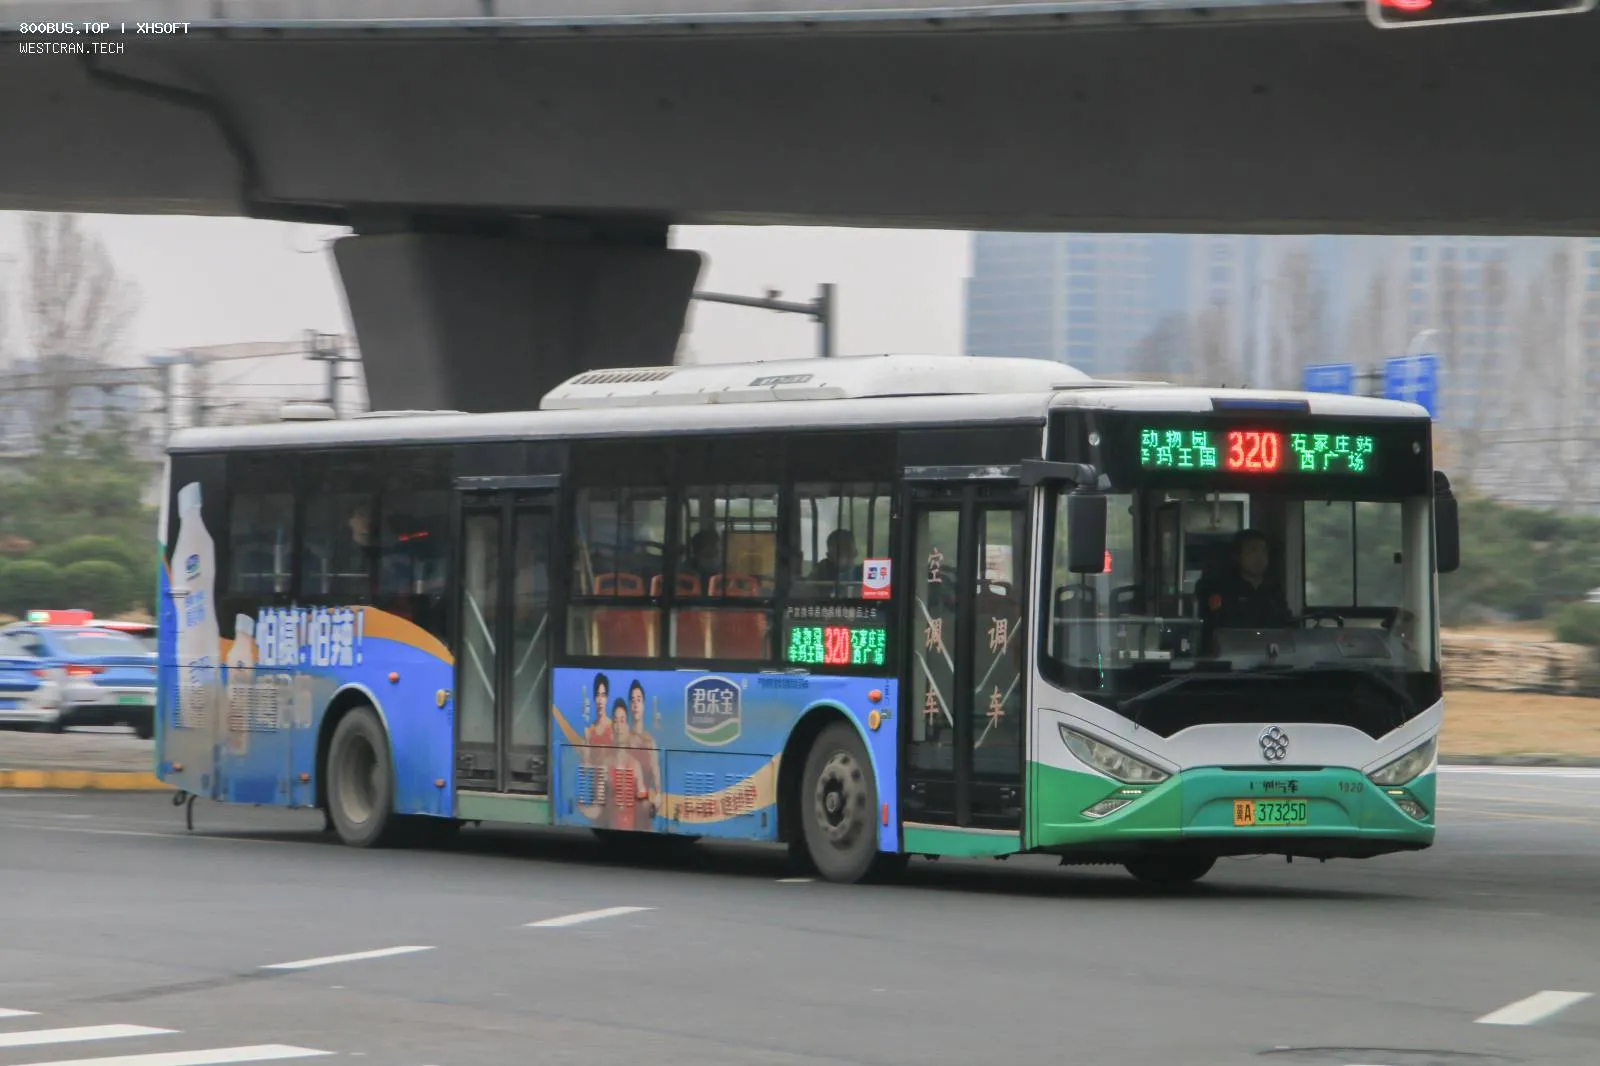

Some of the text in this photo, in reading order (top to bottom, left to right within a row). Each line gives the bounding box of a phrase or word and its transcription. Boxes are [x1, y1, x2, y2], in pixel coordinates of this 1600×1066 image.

[1141, 429, 1207, 448] 动物园
[1227, 431, 1279, 470] 320
[1290, 433, 1373, 453] 石家庄站
[1300, 451, 1365, 472] 西广场
[824, 627, 851, 664] 320
[922, 547, 944, 727] 空调车
[692, 688, 734, 716] 君乐宝
